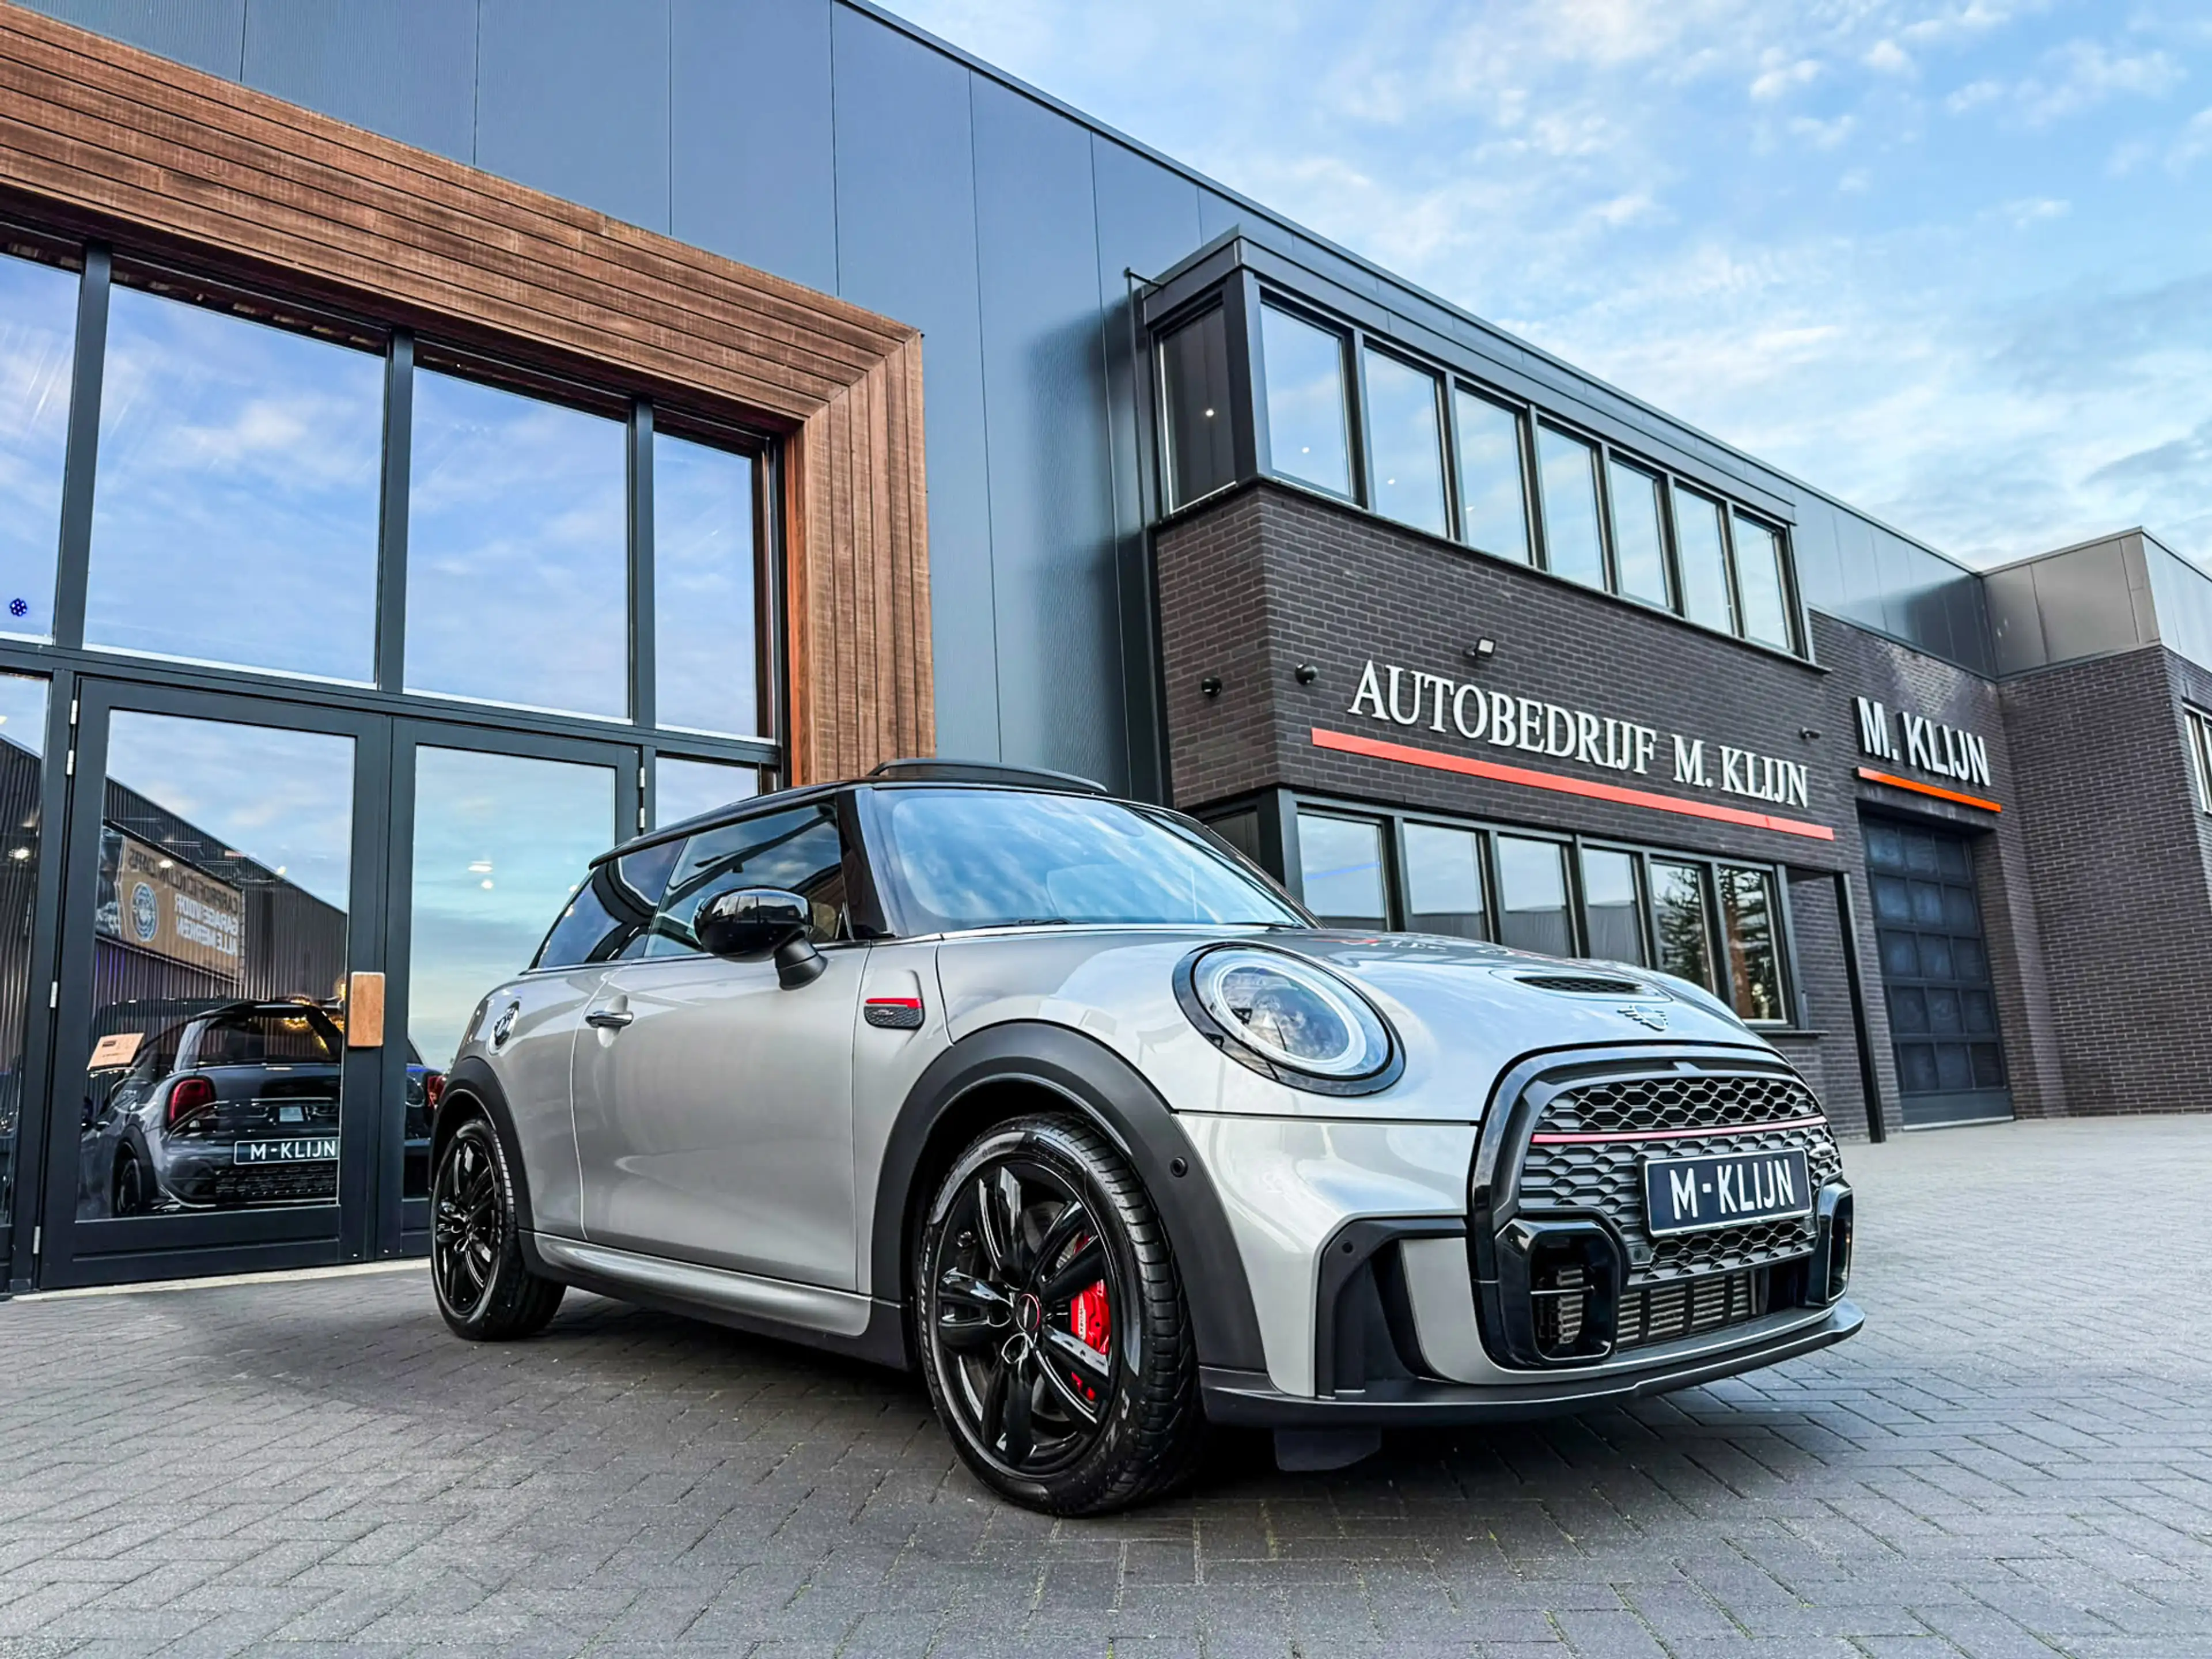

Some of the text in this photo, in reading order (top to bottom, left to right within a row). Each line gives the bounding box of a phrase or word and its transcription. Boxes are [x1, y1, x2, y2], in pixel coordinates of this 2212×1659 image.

[1347, 659, 1809, 808] AUTOBEDRIJF M. KLIJN
[1856, 695, 1991, 787] M. KLIJN
[250, 1140, 336, 1160] M-KLIJN
[1669, 1158, 1796, 1220] M-KLIJN
